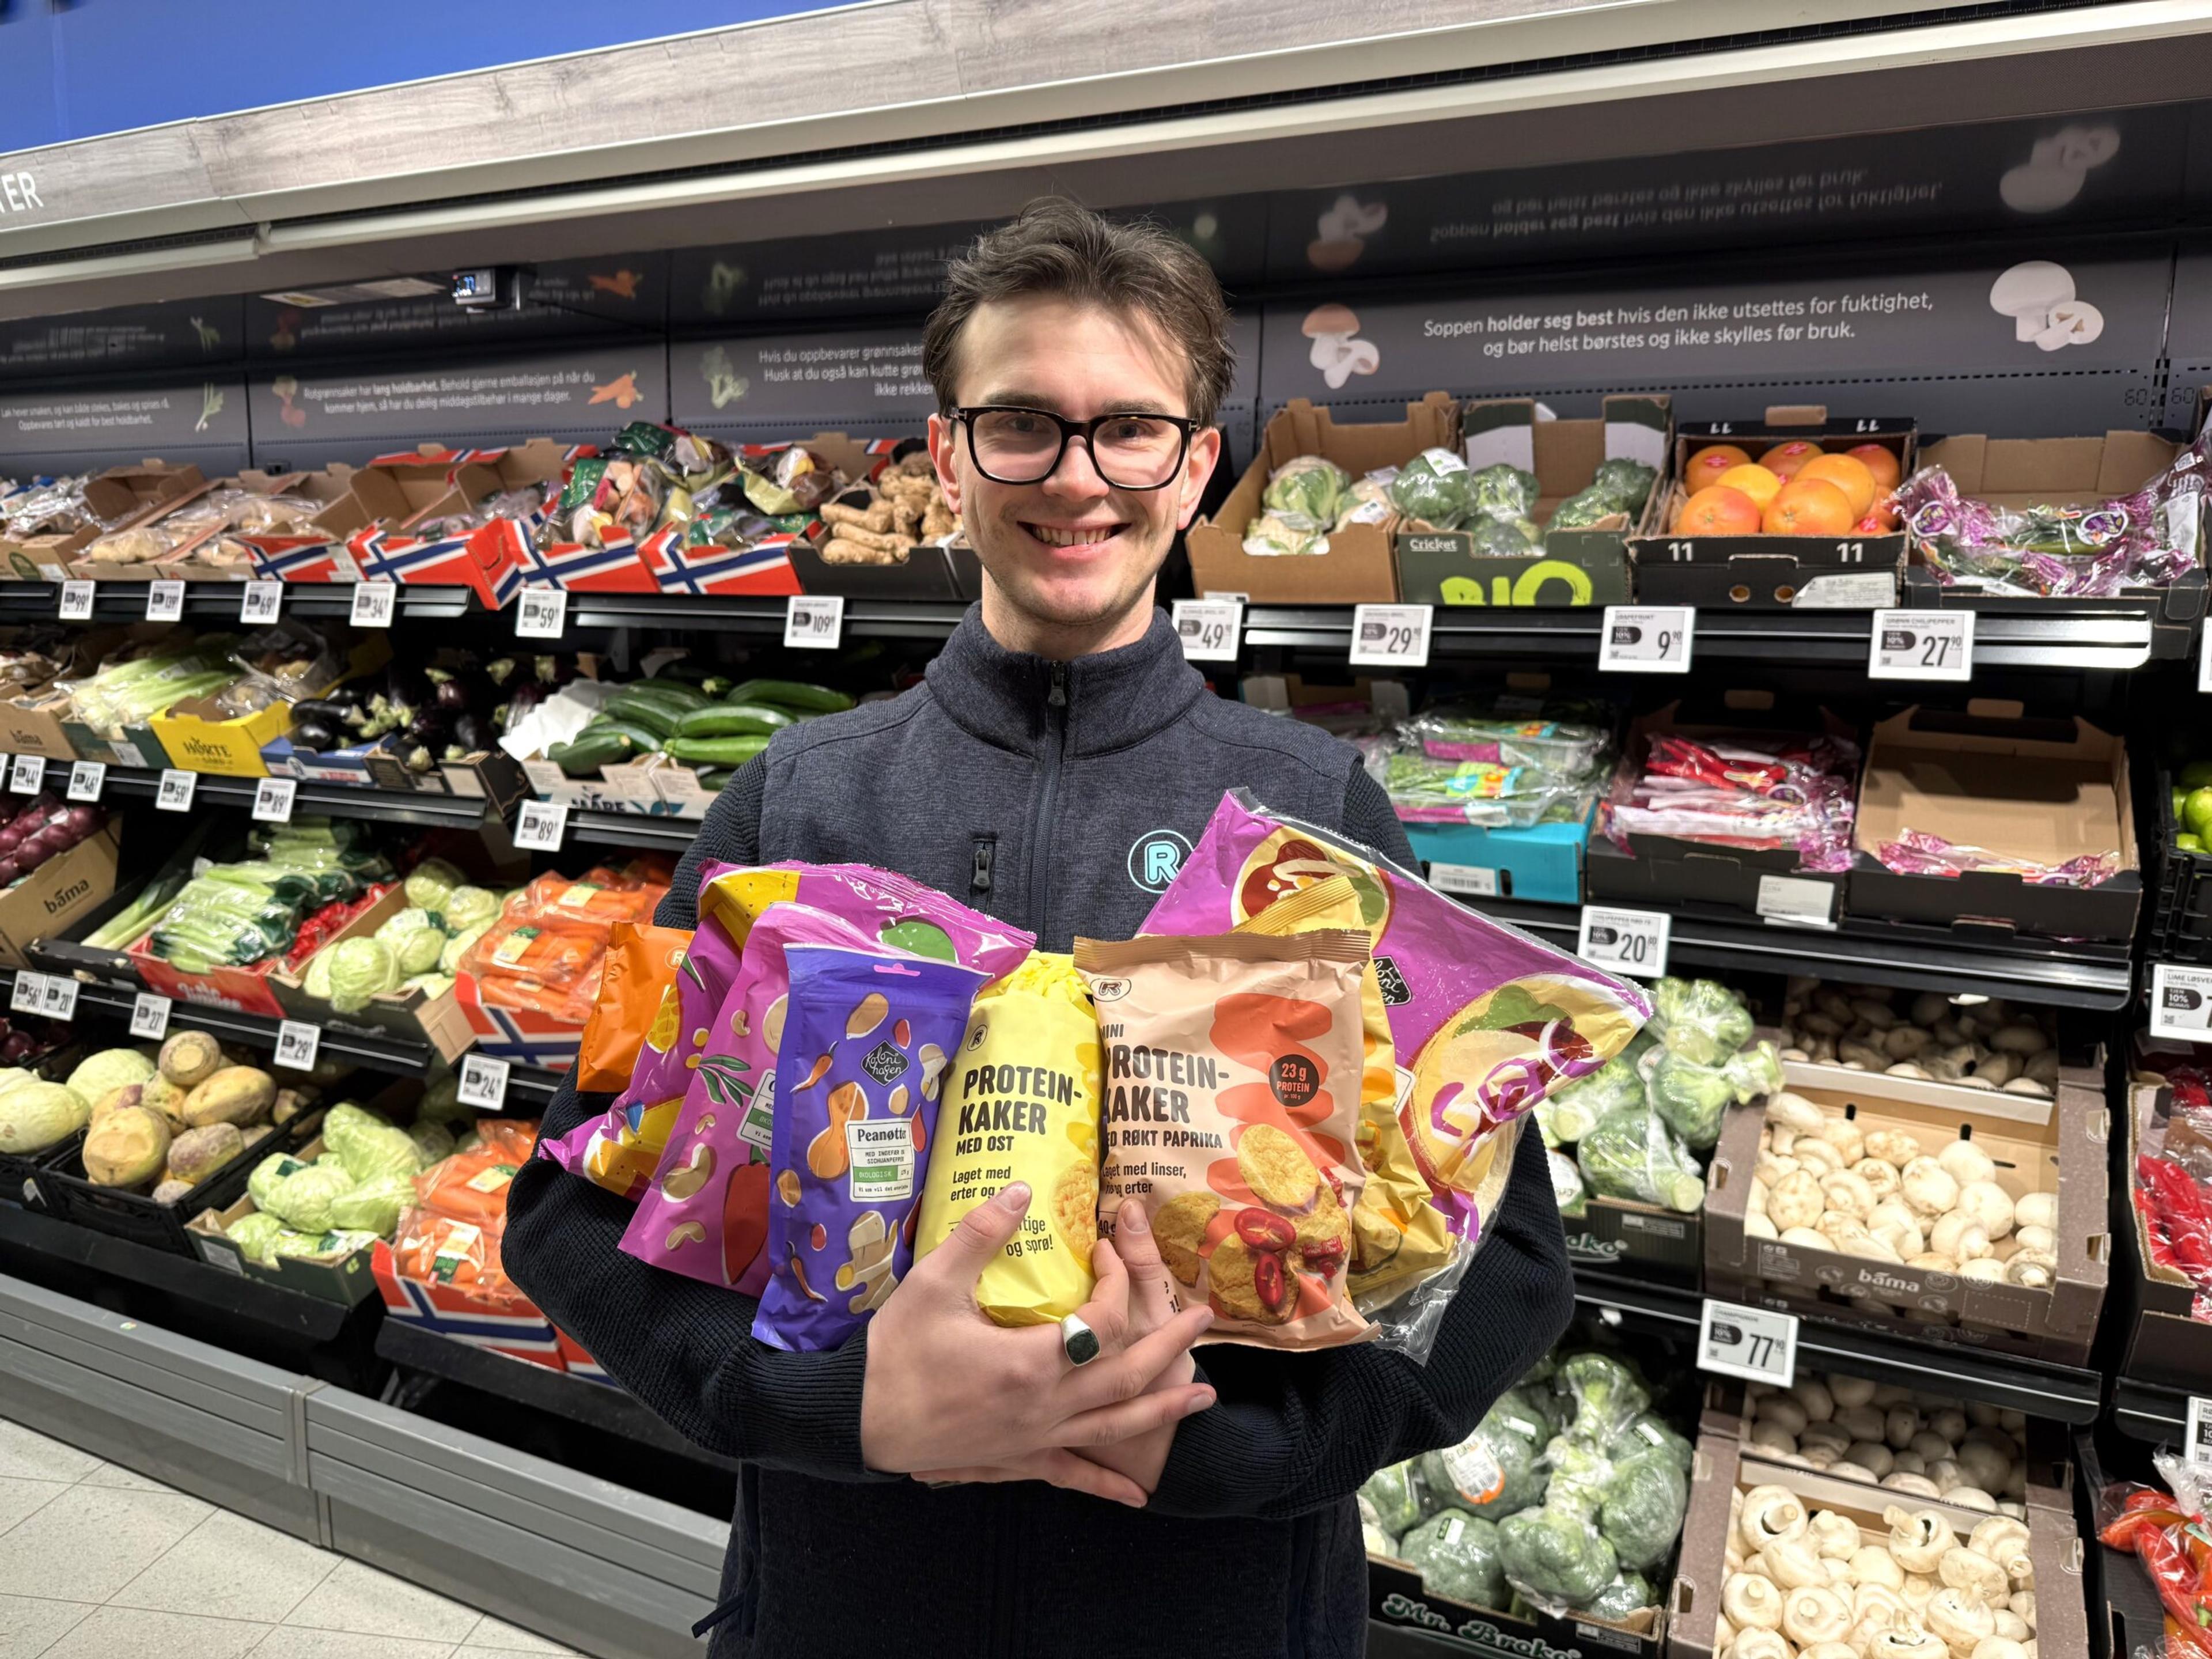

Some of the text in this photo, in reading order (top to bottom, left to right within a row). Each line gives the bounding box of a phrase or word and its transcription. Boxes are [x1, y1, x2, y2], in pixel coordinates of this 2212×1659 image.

[0, 172, 43, 212] ER
[1423, 291, 1933, 339] Soppen holder seg best hvis den ikke utsettes for fuktighet,
[1483, 320, 1856, 358] og bør helst børstes og ikke skylles før bruk.
[759, 350, 781, 363] Hvis
[783, 349, 797, 362] du
[799, 346, 859, 364] oppbevarer
[764, 369, 790, 382] Husk
[793, 368, 804, 380] at
[806, 366, 820, 380] du
[823, 363, 846, 382] også
[849, 364, 868, 378] kan
[870, 363, 899, 377] kutte
[874, 383, 897, 396] ikke
[2124, 389, 2147, 406] 60
[2171, 387, 2195, 404] 60
[1410, 537, 1457, 551] Cricket
[1668, 543, 1694, 561] 11
[1837, 543, 1862, 562] 11
[540, 608, 554, 628] 59
[813, 616, 831, 632] 109
[1202, 623, 1224, 649] 49
[1388, 627, 1412, 653] 29
[1658, 630, 1671, 659] 9
[1922, 635, 1962, 666] 27 90
[537, 821, 553, 841] 89
[1145, 840, 1180, 884] R
[1619, 934, 1646, 962] 20
[2168, 994, 2189, 1003] 10%
[1107, 1044, 1229, 1090] ROTEIN-
[1281, 1063, 1307, 1082] 23 g
[481, 1077, 496, 1096] 24
[963, 1064, 1082, 1107] PROTEIN-
[1276, 1081, 1310, 1093] PROTEIN
[958, 1100, 1046, 1136] KAKER
[956, 1135, 1014, 1157] MED OST
[1123, 1128, 1158, 1146] RØKT
[1163, 1130, 1223, 1149] PAPRIKA
[953, 1166, 1011, 1184] Laget med
[1123, 1161, 1147, 1175] med
[1152, 1162, 1187, 1179] linser,
[950, 1186, 995, 1202] erter og
[1125, 1181, 1153, 1194] erter
[1006, 1234, 1054, 1257] og sprø!
[1748, 1333, 1774, 1368] 77
